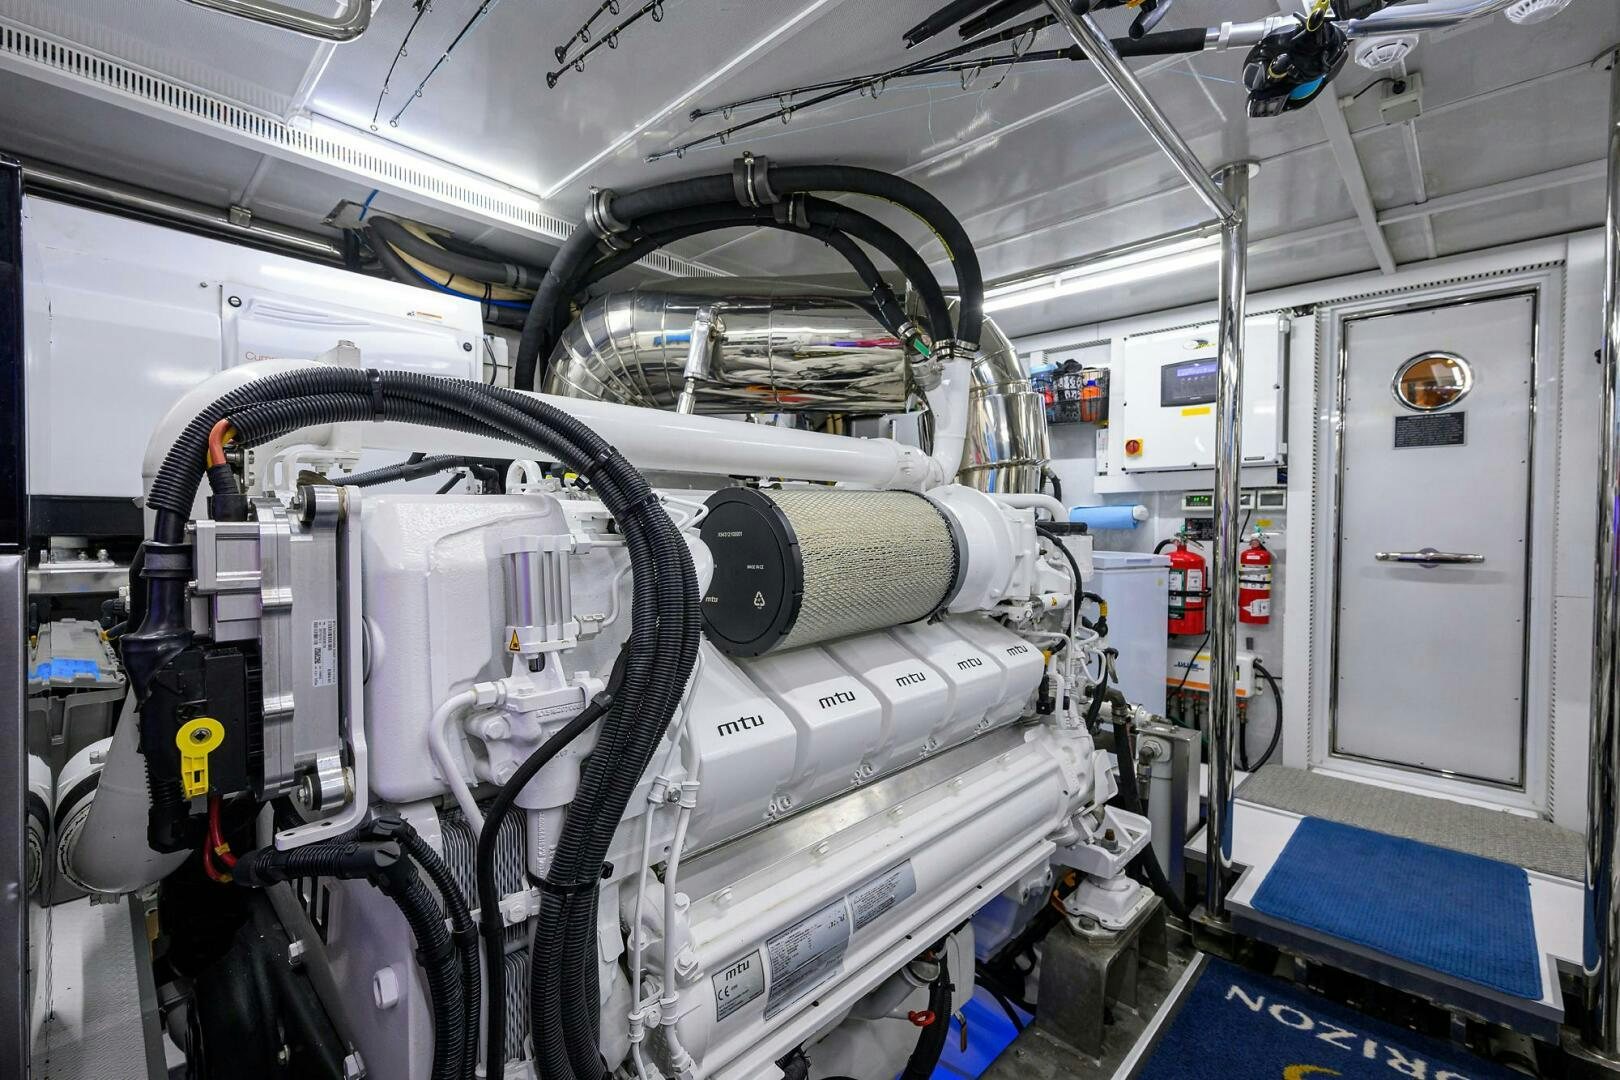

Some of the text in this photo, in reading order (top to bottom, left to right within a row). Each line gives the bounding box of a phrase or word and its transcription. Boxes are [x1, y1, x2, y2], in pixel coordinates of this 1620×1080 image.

[1006, 643, 1029, 657] mtu
[957, 656, 983, 671] mtu
[895, 670, 926, 688] mtu
[818, 689, 856, 709] mtu
[716, 713, 765, 737] mtu
[724, 960, 750, 981] mtu
